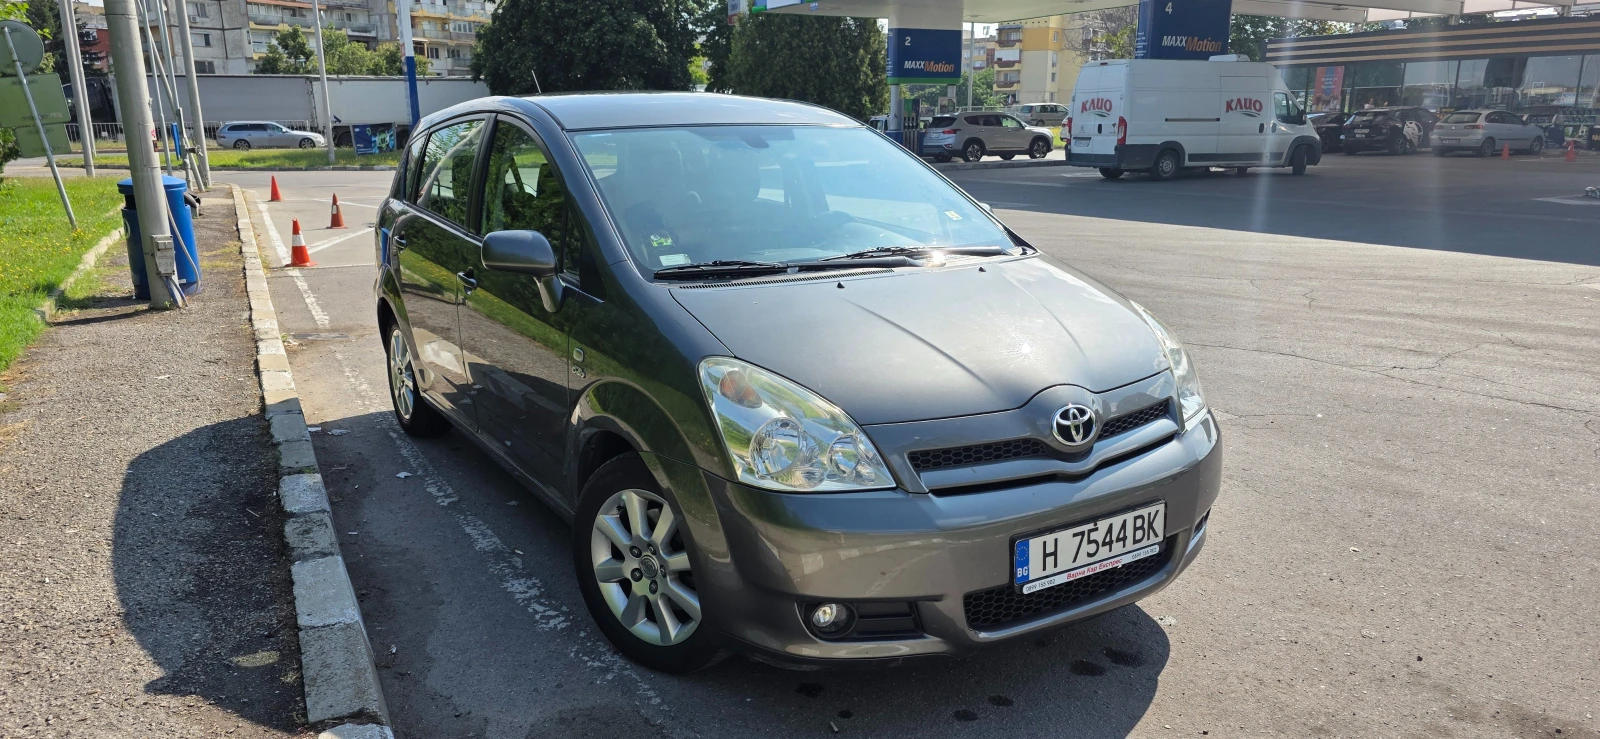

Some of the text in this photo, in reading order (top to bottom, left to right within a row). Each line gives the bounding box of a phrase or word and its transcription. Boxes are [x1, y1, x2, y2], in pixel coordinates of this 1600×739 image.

[1165, 2, 1173, 14] 4
[904, 36, 911, 46] 2
[1042, 537, 1059, 572] H
[1016, 568, 1029, 577] BG
[1066, 558, 1123, 580] Варна Кар Експрес
